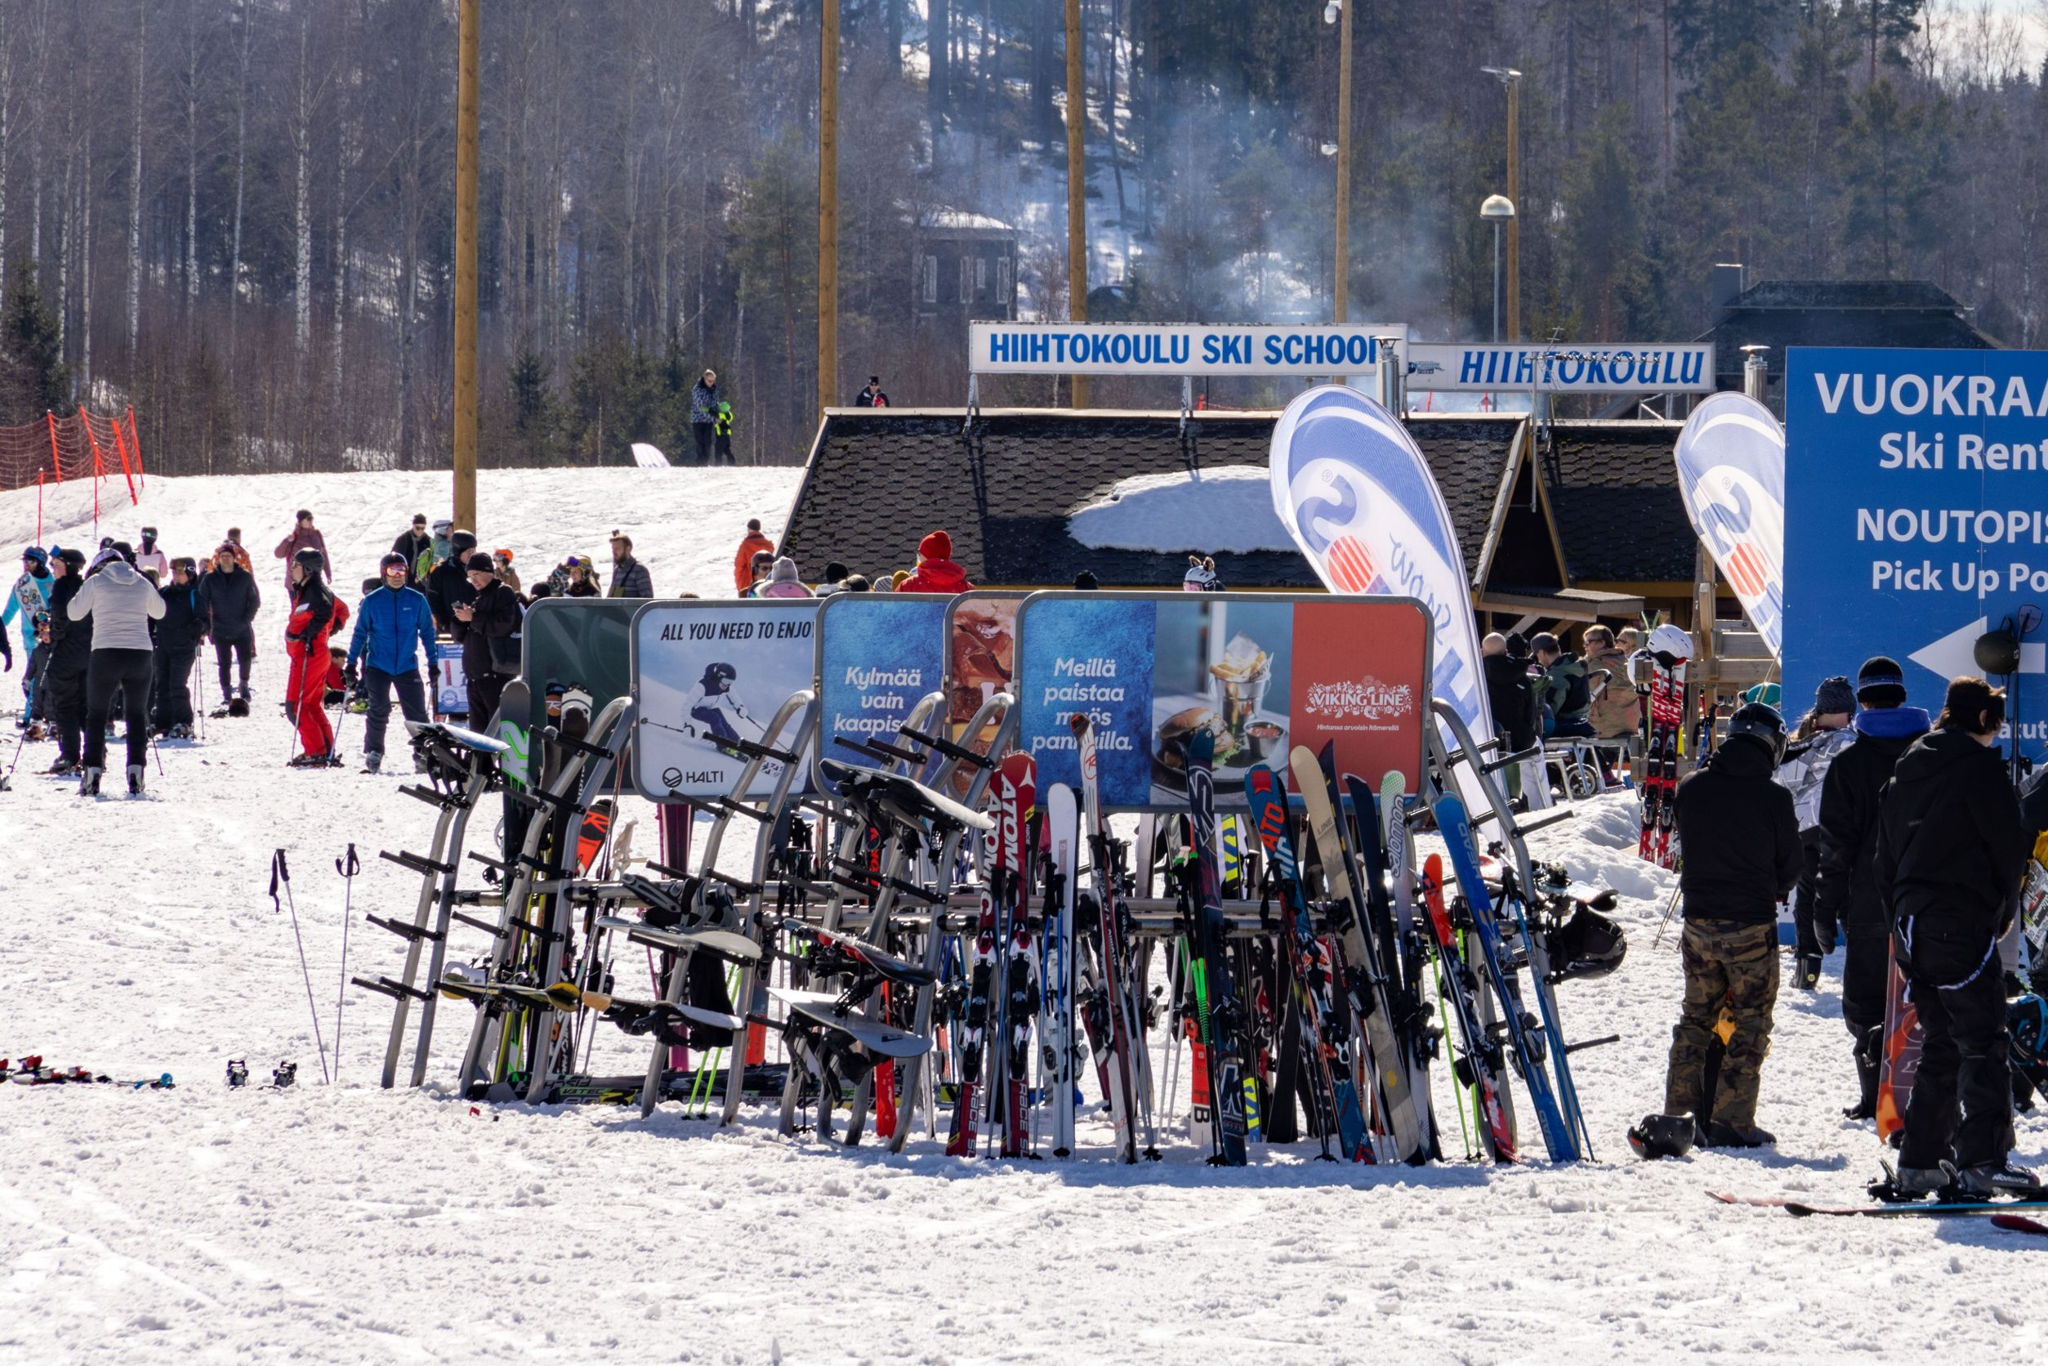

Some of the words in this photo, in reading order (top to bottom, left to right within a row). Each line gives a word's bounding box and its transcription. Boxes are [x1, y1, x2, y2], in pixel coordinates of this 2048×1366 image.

[990, 333, 1190, 364] HIIHTOKOULU
[1202, 334, 1252, 364] SKI
[1460, 351, 1705, 384] HIIHTOKOULU
[1879, 432, 1943, 470] Ski
[1857, 508, 2048, 544] NOUTOPI
[1872, 560, 1942, 592] Pick
[1952, 562, 1999, 599] Up
[2010, 563, 2048, 593] Po
[661, 624, 684, 640] ALL
[689, 623, 716, 640] YOU
[718, 622, 753, 639] NEED
[758, 622, 774, 639] TO
[845, 666, 921, 691] Kylmää
[1054, 657, 1116, 677] Meillä
[861, 691, 904, 709] vain
[1043, 682, 1125, 706] paistaa
[1313, 694, 1367, 706] VIKING
[1371, 694, 1404, 706] LINE
[1055, 707, 1112, 726] mös
[686, 770, 724, 784] HALTI
[1259, 801, 1286, 852] ATO
[1388, 794, 1404, 879] salomon
[1456, 821, 1481, 880] HEAD
